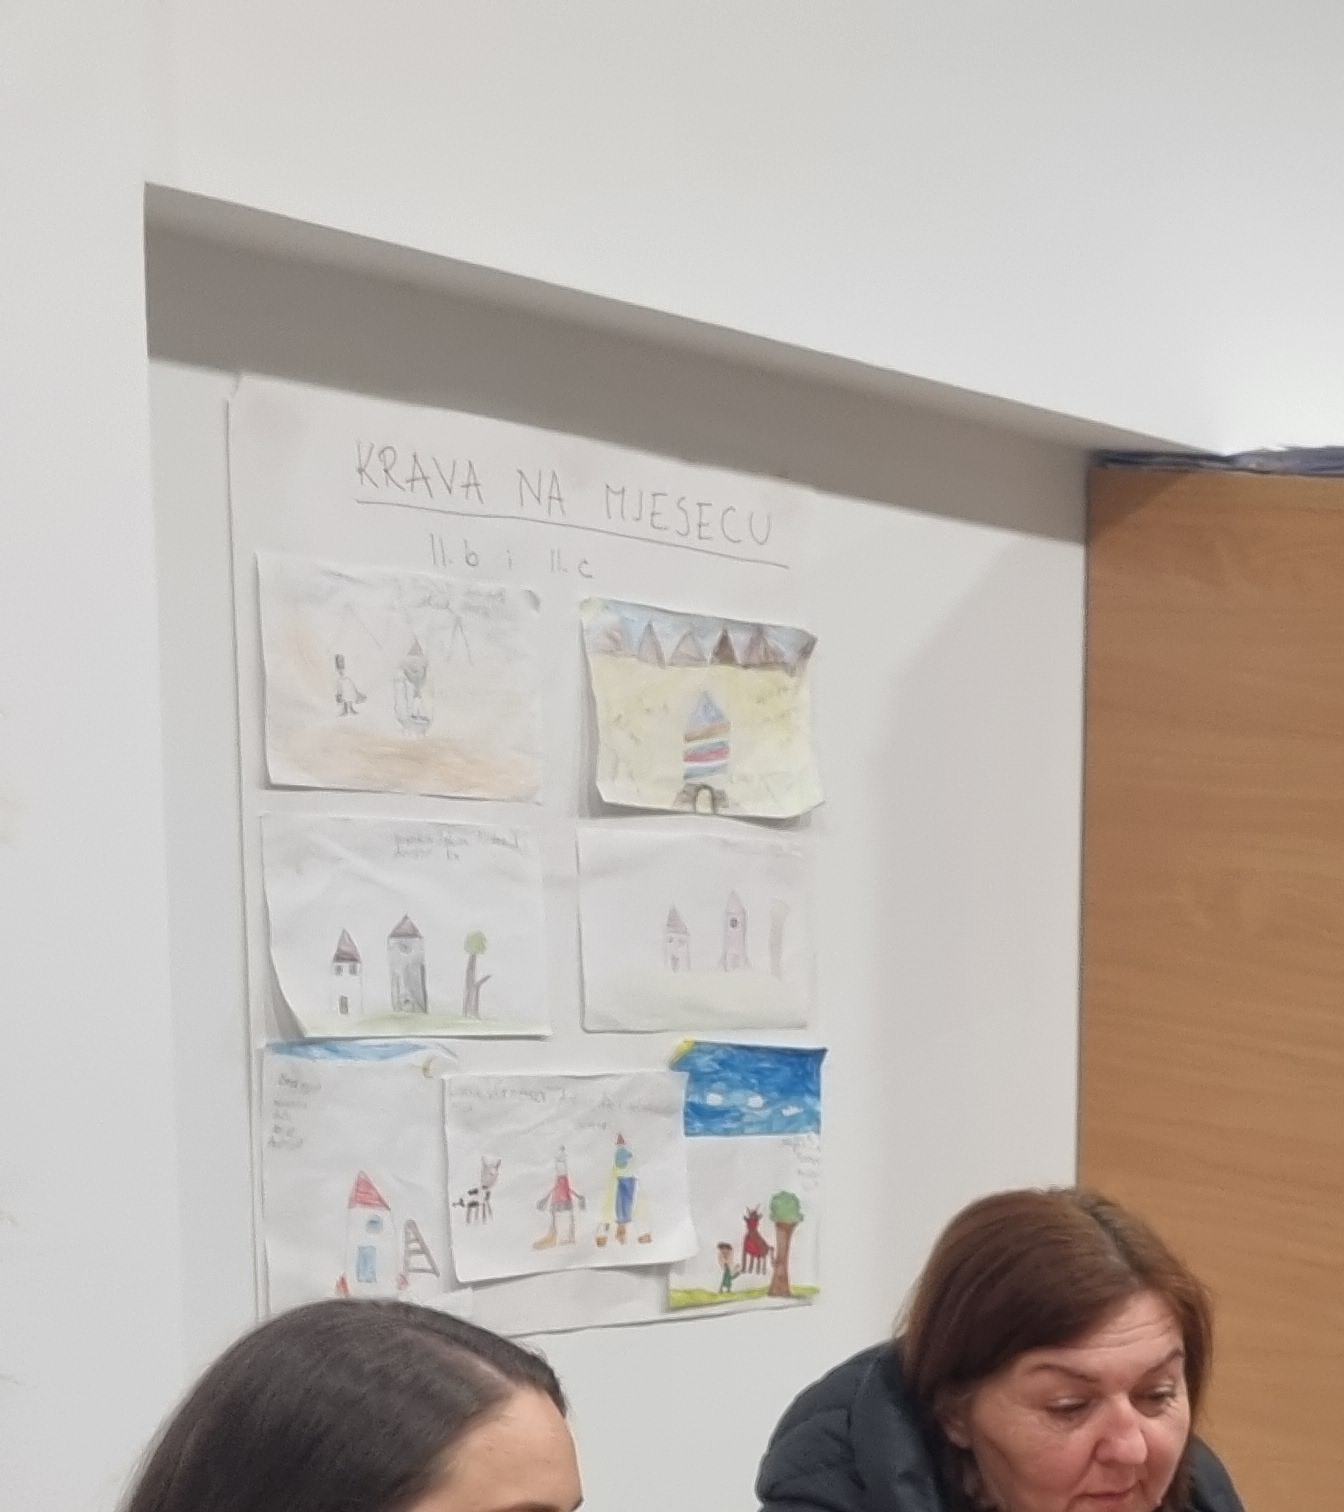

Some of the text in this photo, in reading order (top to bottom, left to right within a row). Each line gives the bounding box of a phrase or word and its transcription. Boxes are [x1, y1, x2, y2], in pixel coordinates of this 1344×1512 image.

[355, 440, 773, 547] KRAVA NA MJESECU
